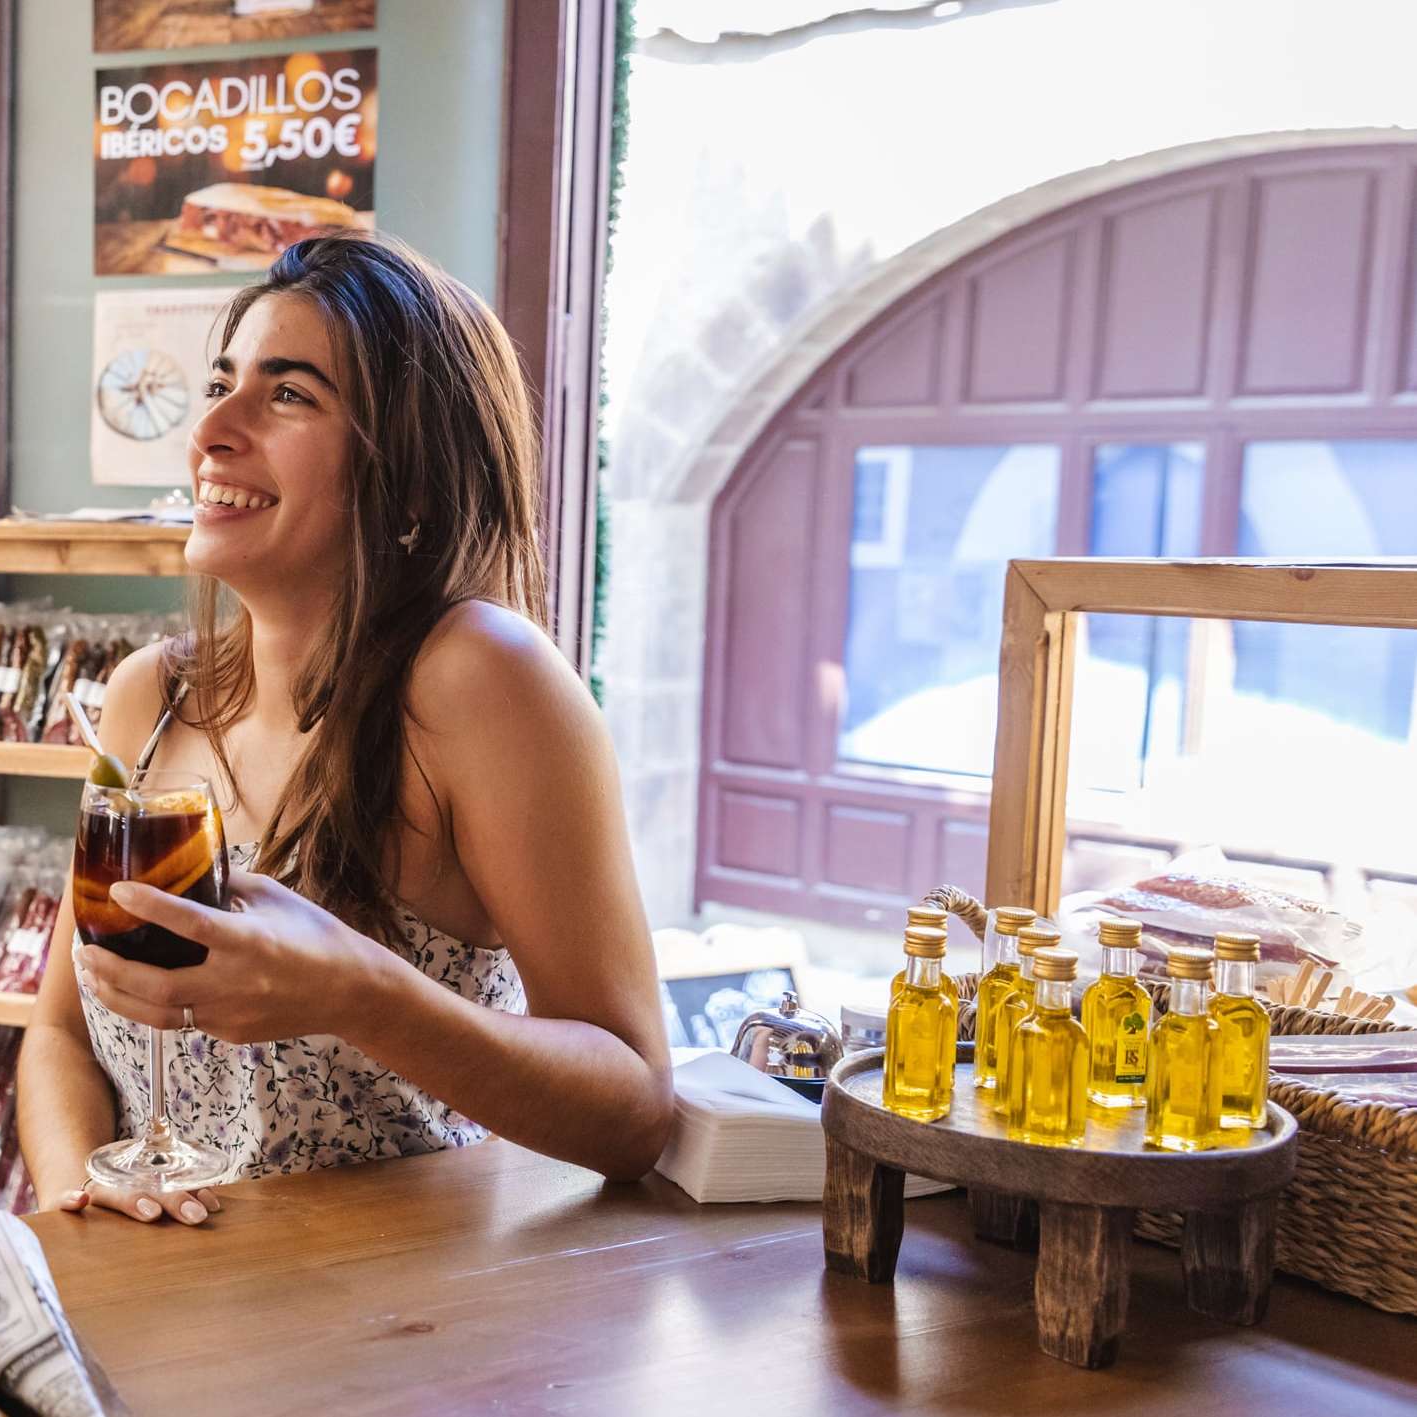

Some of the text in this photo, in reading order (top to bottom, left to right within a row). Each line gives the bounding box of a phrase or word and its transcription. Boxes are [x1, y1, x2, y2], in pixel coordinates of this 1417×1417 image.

[100, 68, 362, 128] BOCADILLOS
[100, 113, 362, 169] IBÉRICOS 5,50€
